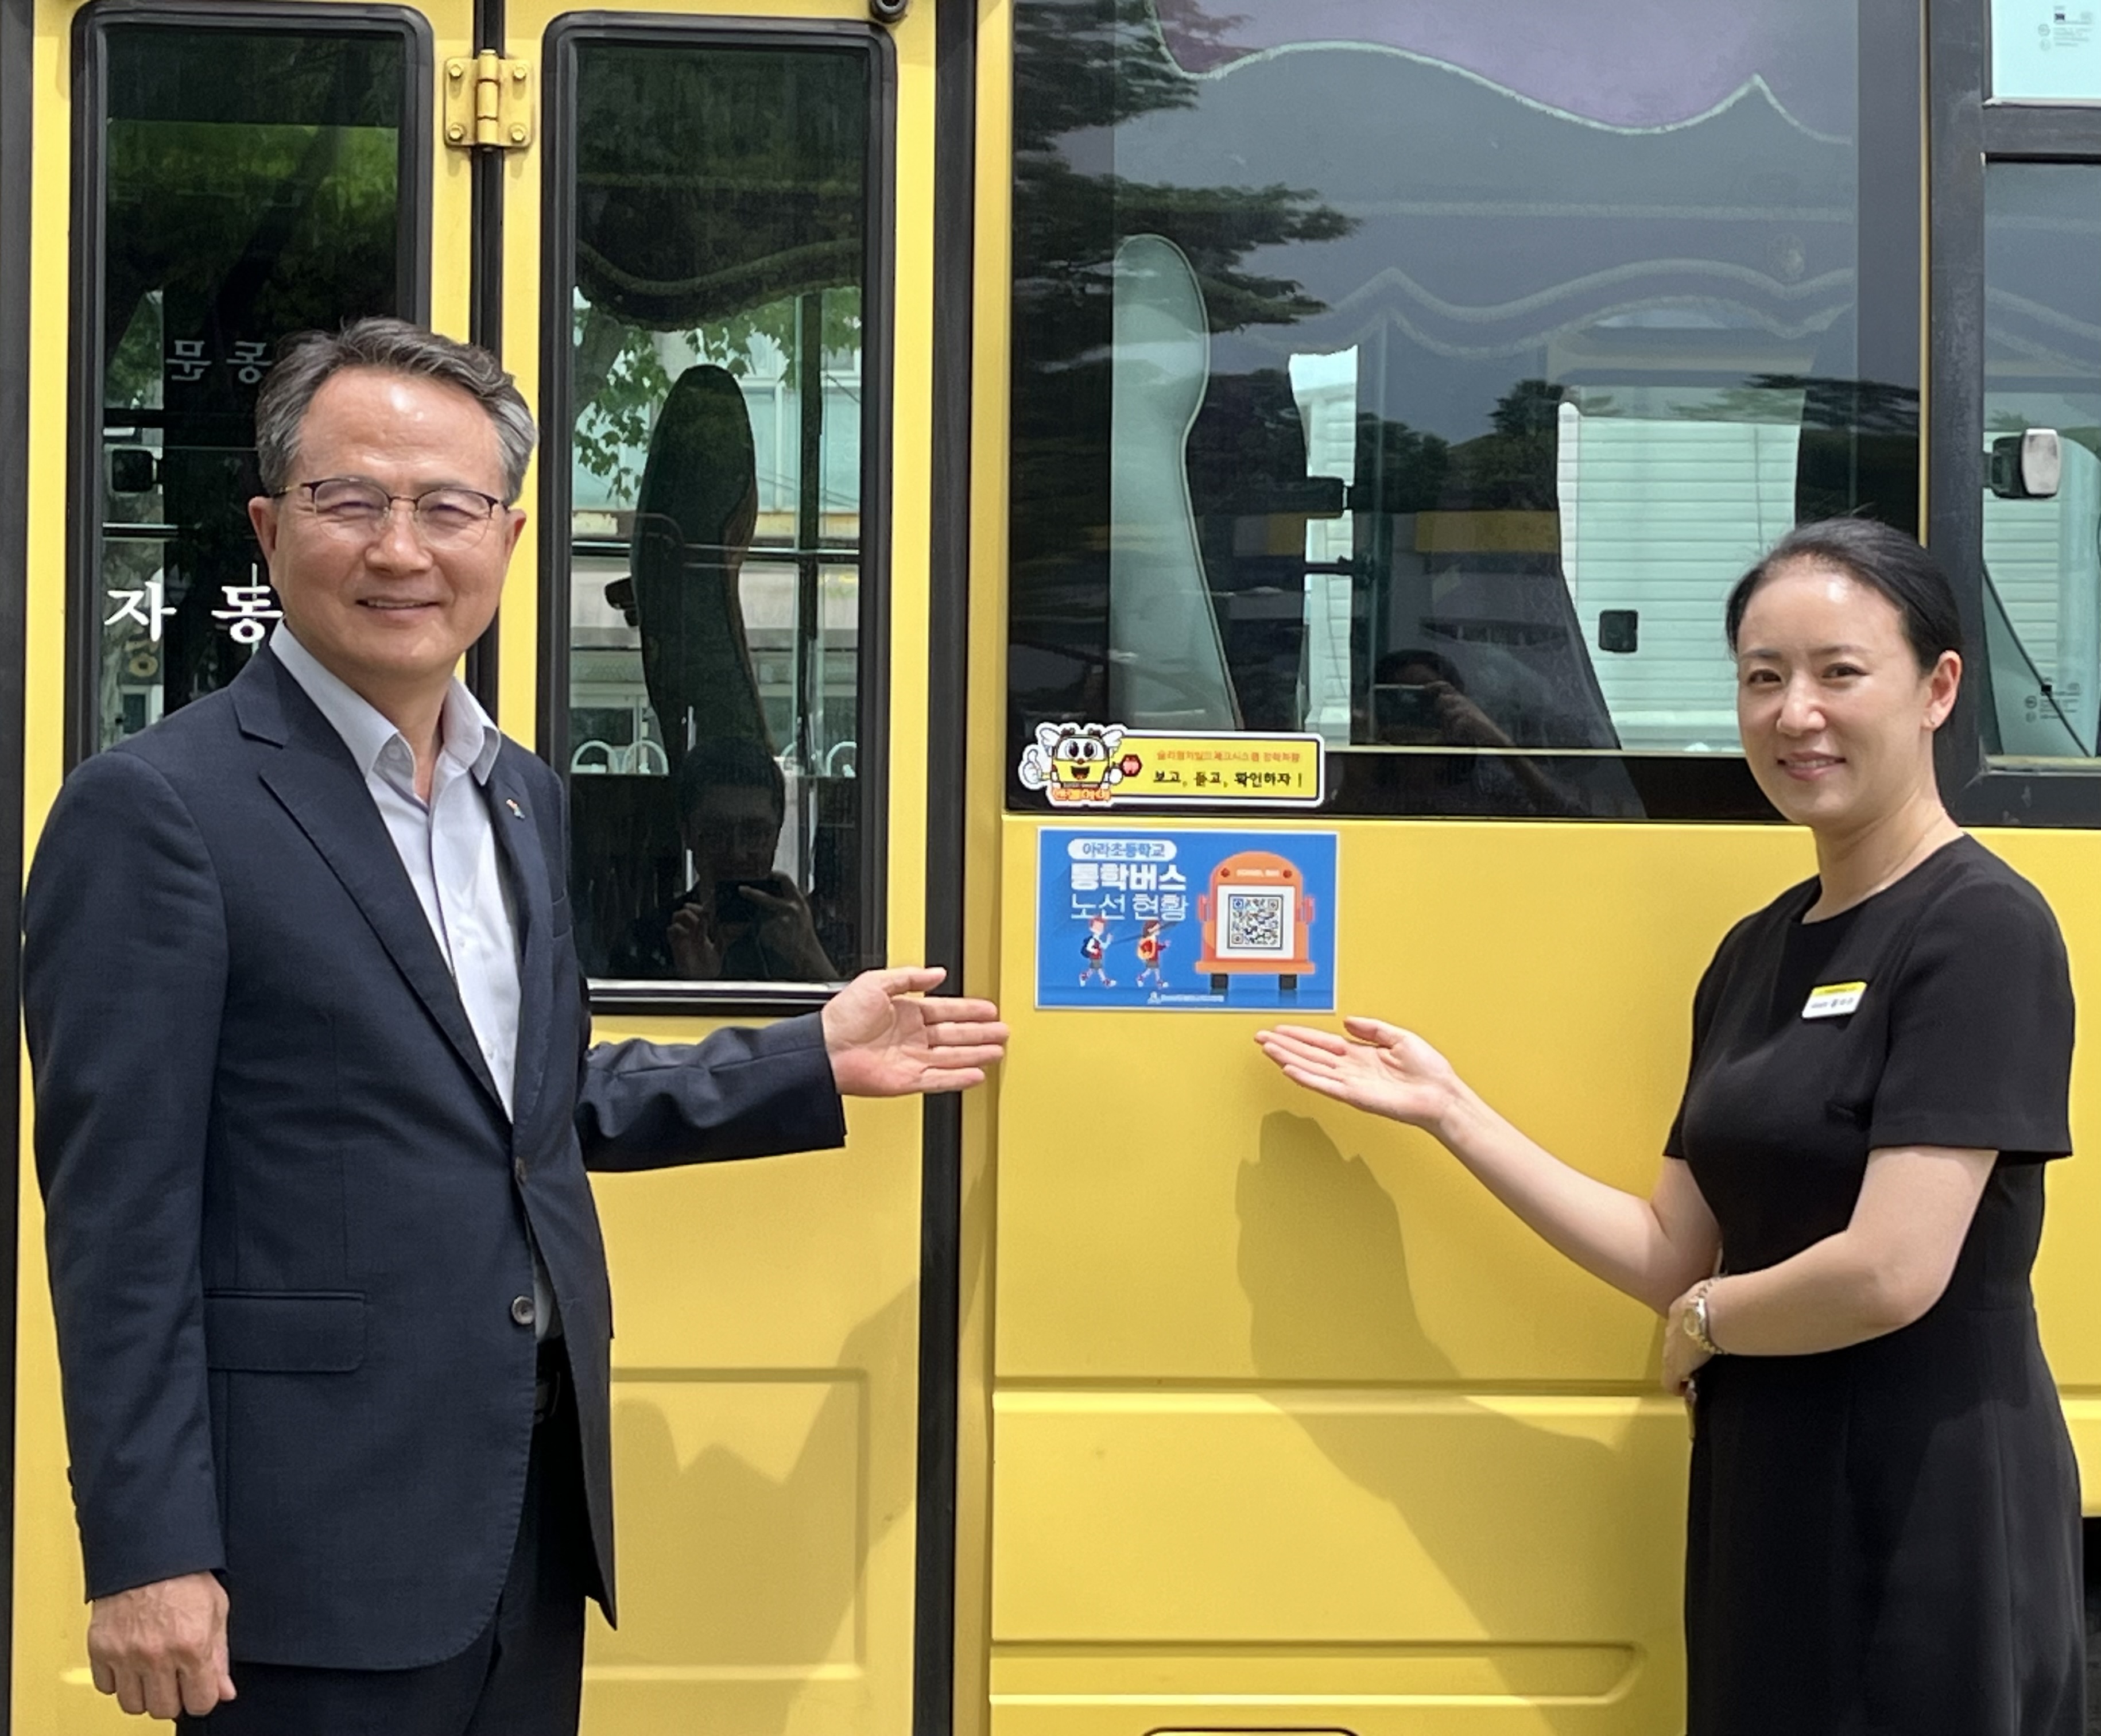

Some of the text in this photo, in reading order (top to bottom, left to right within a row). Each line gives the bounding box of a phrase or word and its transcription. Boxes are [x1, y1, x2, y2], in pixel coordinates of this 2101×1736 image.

[1153, 770, 1188, 788] 보고,
[1234, 771, 1291, 788] 확인하자
[1082, 842, 1165, 858] 아라초등학교
[1071, 862, 1187, 892] 통학버스
[1071, 893, 1189, 922] 노선 현황
